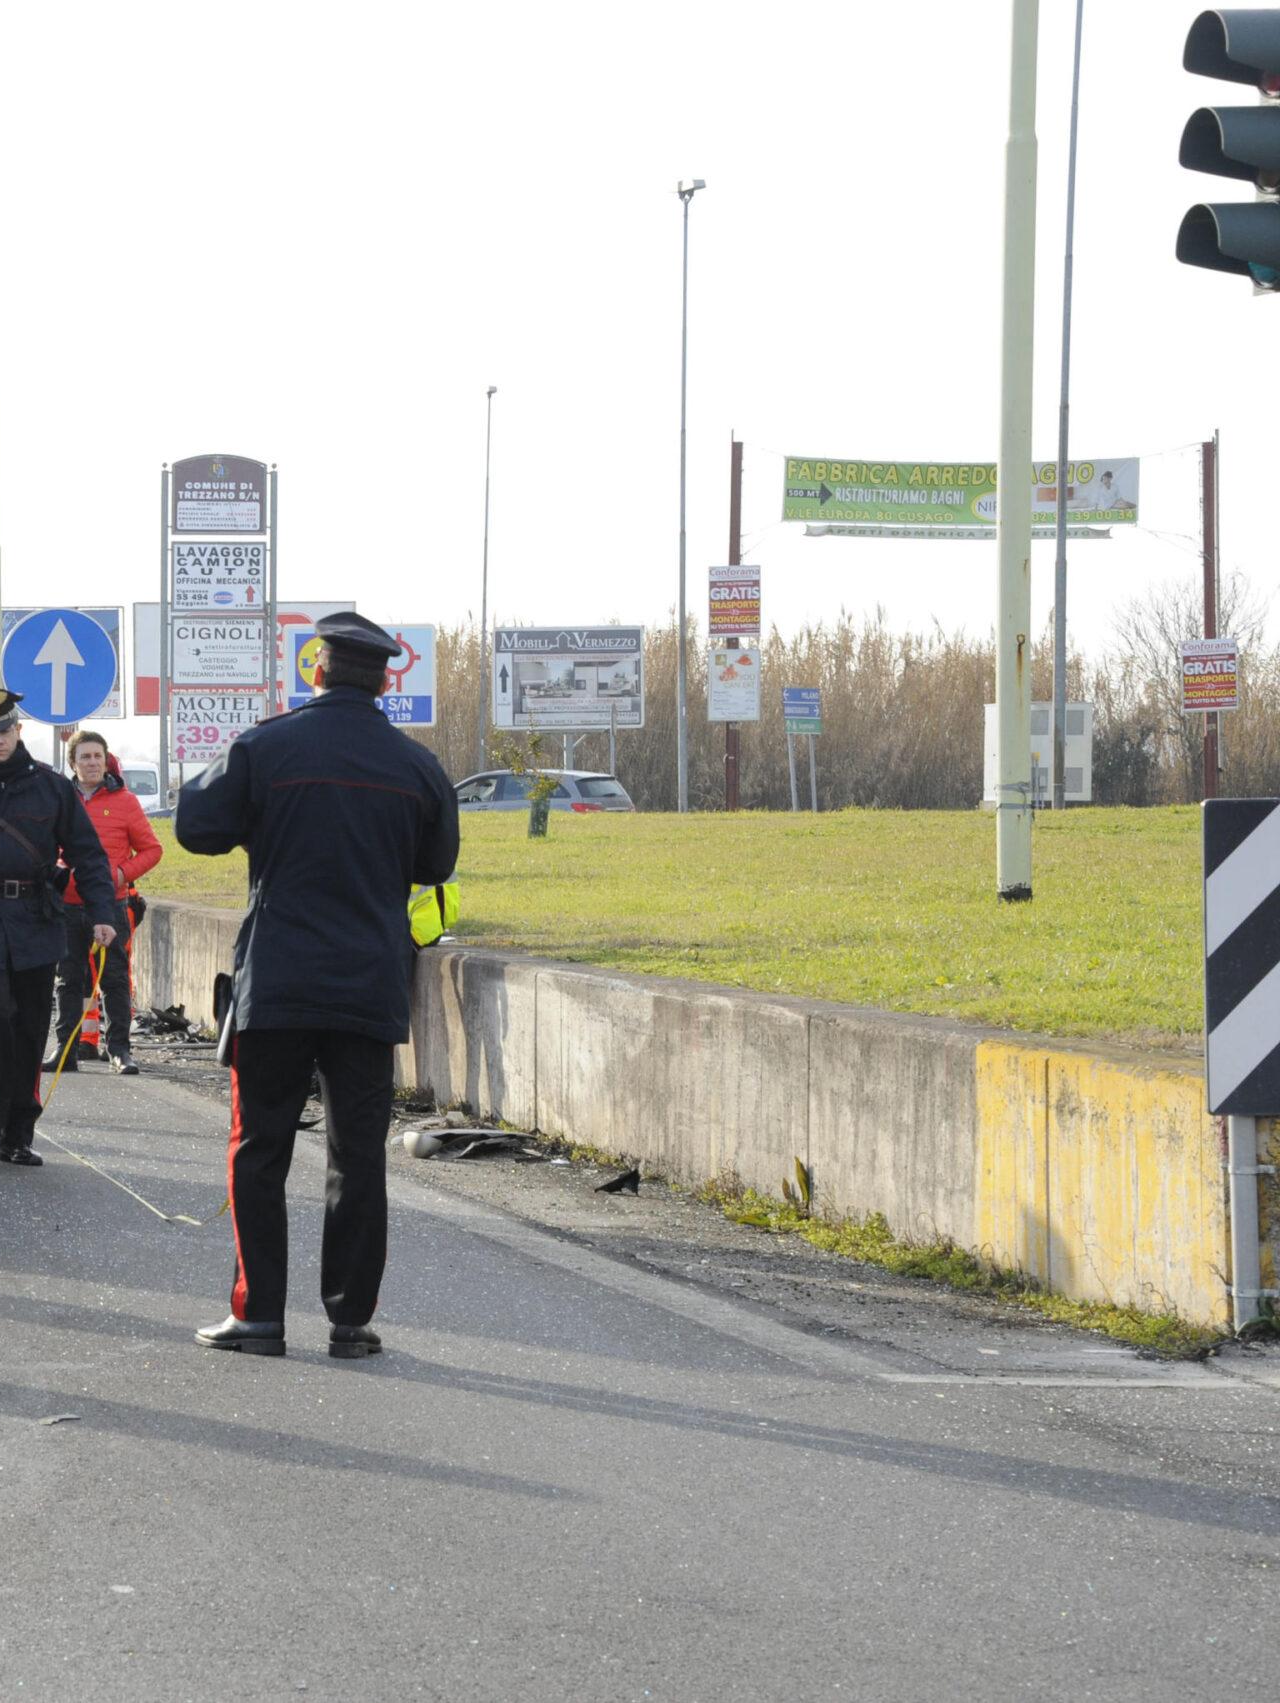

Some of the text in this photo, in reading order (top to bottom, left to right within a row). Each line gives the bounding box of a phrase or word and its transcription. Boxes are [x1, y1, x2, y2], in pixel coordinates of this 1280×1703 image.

[787, 459, 900, 484] FABBRICA
[185, 482, 253, 490] COMUNE DI
[178, 491, 260, 501] TREZZANO S/N
[788, 490, 820, 499] 500 MT
[835, 487, 965, 505] RISTRUTTURIAMO BAGNI
[786, 508, 812, 518] V.LE
[819, 510, 871, 521] EUROPA
[897, 511, 954, 522] CUSAGO
[826, 527, 883, 536] APERTI
[891, 529, 975, 538] DOMENICA
[176, 546, 261, 558] LAVAGGIO
[176, 558, 261, 567] CAMION
[176, 567, 261, 576] AUTO
[709, 567, 760, 577] Conforama
[192, 593, 209, 601] 494
[710, 586, 760, 600] GRATIS
[710, 601, 760, 609] TRASPORTO
[710, 615, 760, 624] MONTAGGIO
[177, 627, 262, 640] CIGNOLI
[1182, 642, 1236, 653] Conforama
[1184, 660, 1236, 675] GRATIS
[1184, 674, 1237, 684] TRASPORTO
[1184, 688, 1237, 698] MONTAGGIO
[177, 696, 260, 711] MOTEL
[388, 697, 413, 712] S/N
